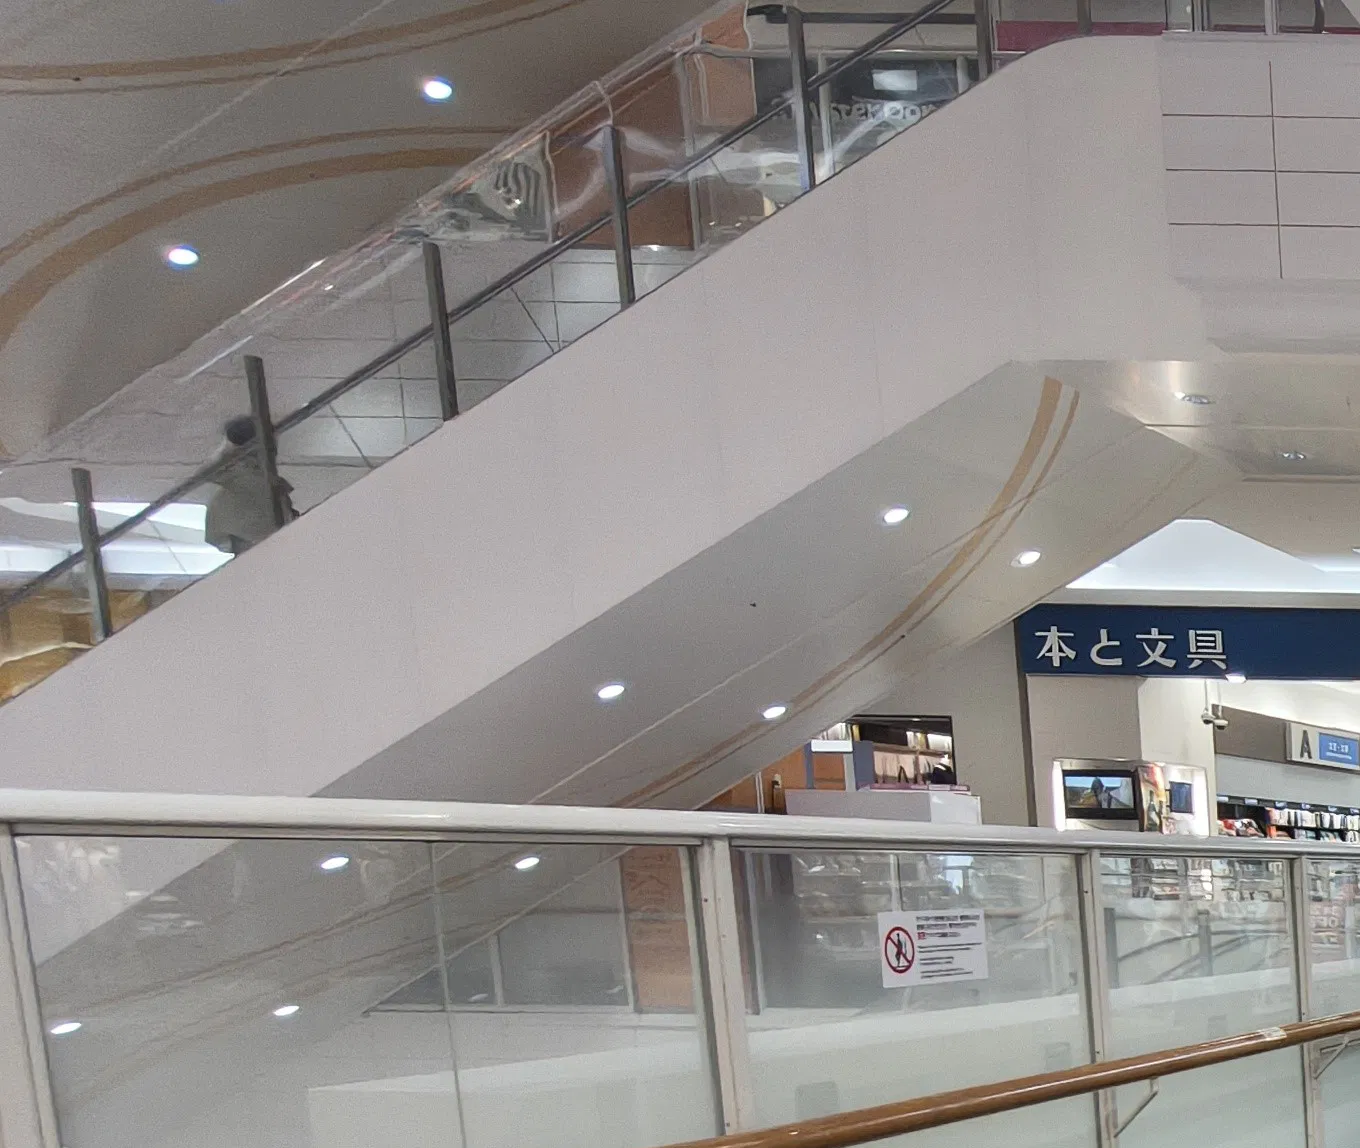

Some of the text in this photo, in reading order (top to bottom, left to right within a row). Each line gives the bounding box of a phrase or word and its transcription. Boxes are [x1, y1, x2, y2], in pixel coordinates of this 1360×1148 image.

[1034, 625, 1227, 670] 本と文具
[1300, 729, 1313, 759] A
